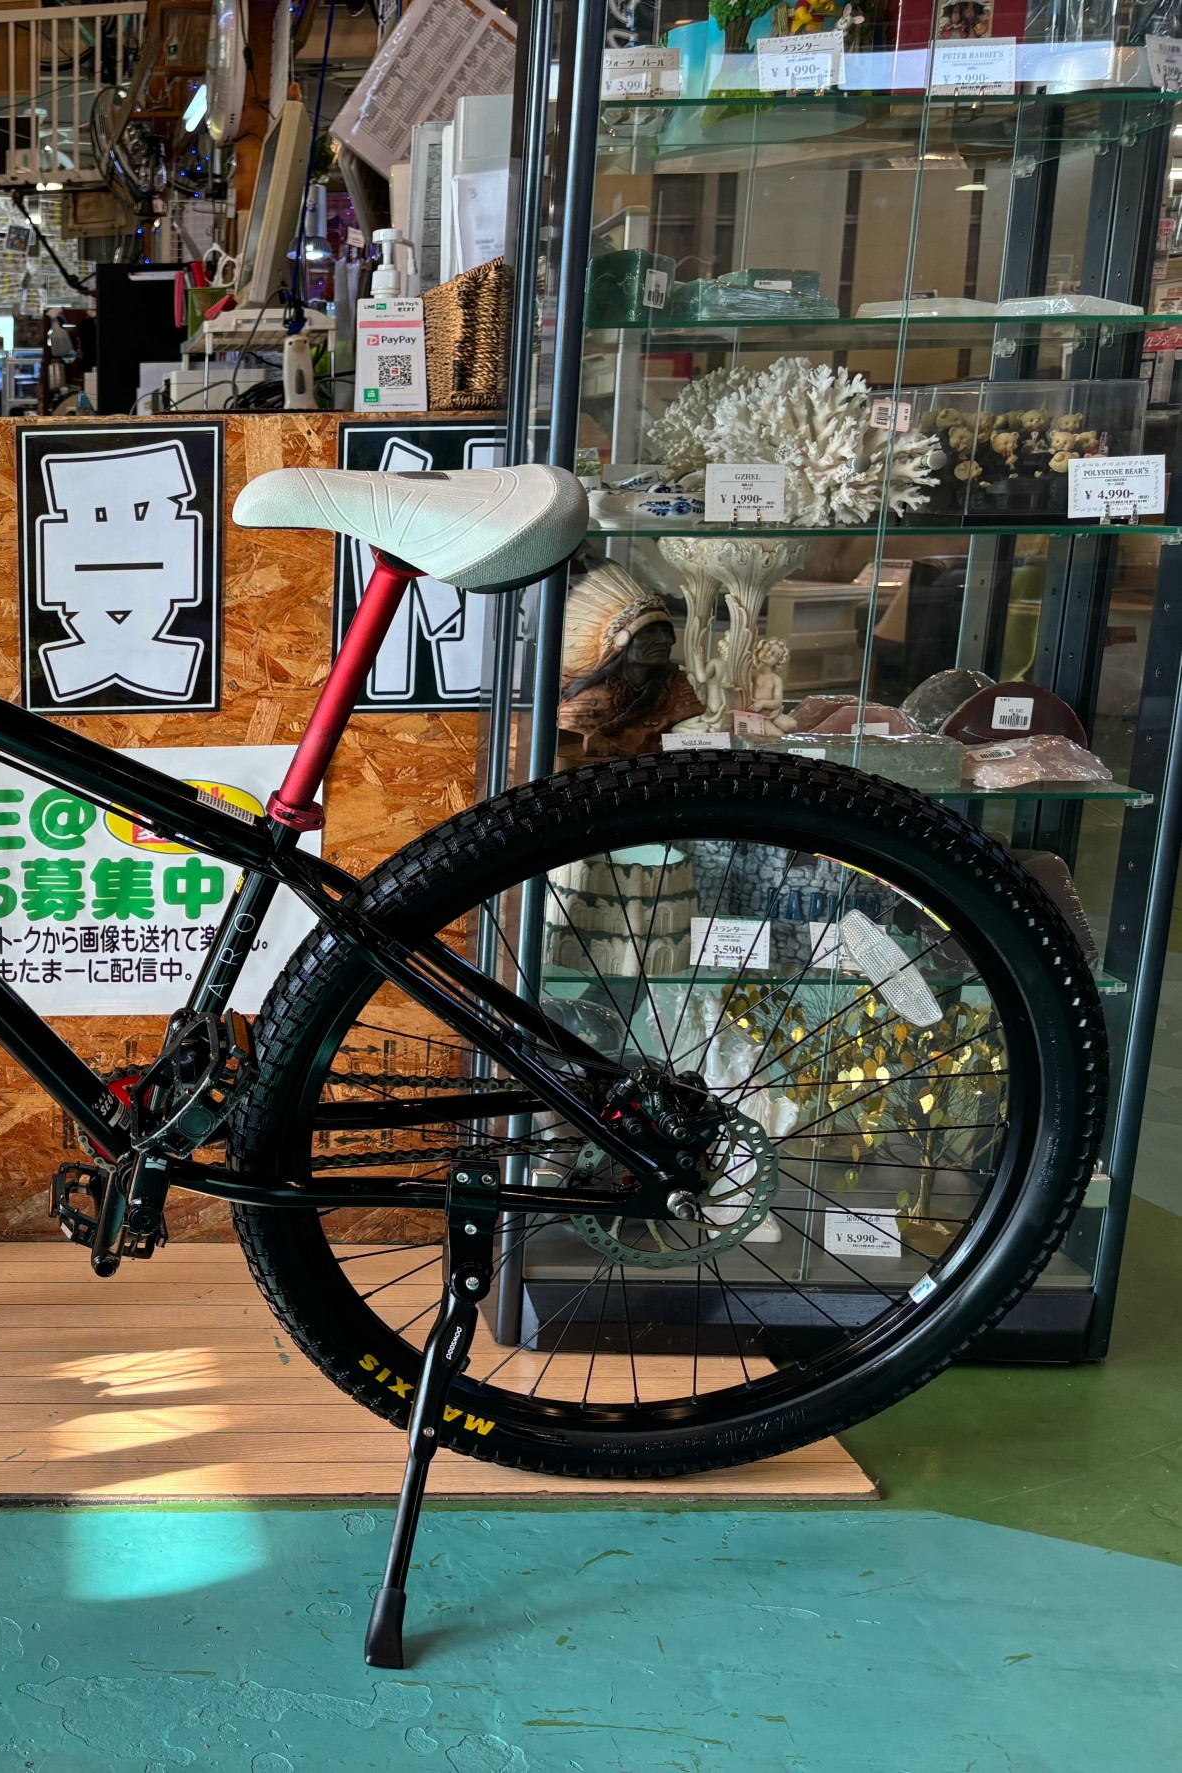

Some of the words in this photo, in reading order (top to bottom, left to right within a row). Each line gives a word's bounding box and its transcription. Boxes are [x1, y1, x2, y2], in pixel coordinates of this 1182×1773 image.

[942, 52, 967, 60] PETER
[381, 335, 417, 345] PayPay
[734, 473, 761, 481] GZHEL
[1083, 469, 1124, 477] POLYSTONE
[1124, 467, 1149, 475] BEAR'S
[1097, 488, 1135, 501] 4,990-
[207, 912, 257, 1000] ARO
[846, 1233, 879, 1244] 8,990-
[358, 1353, 496, 1436] MAXIS
